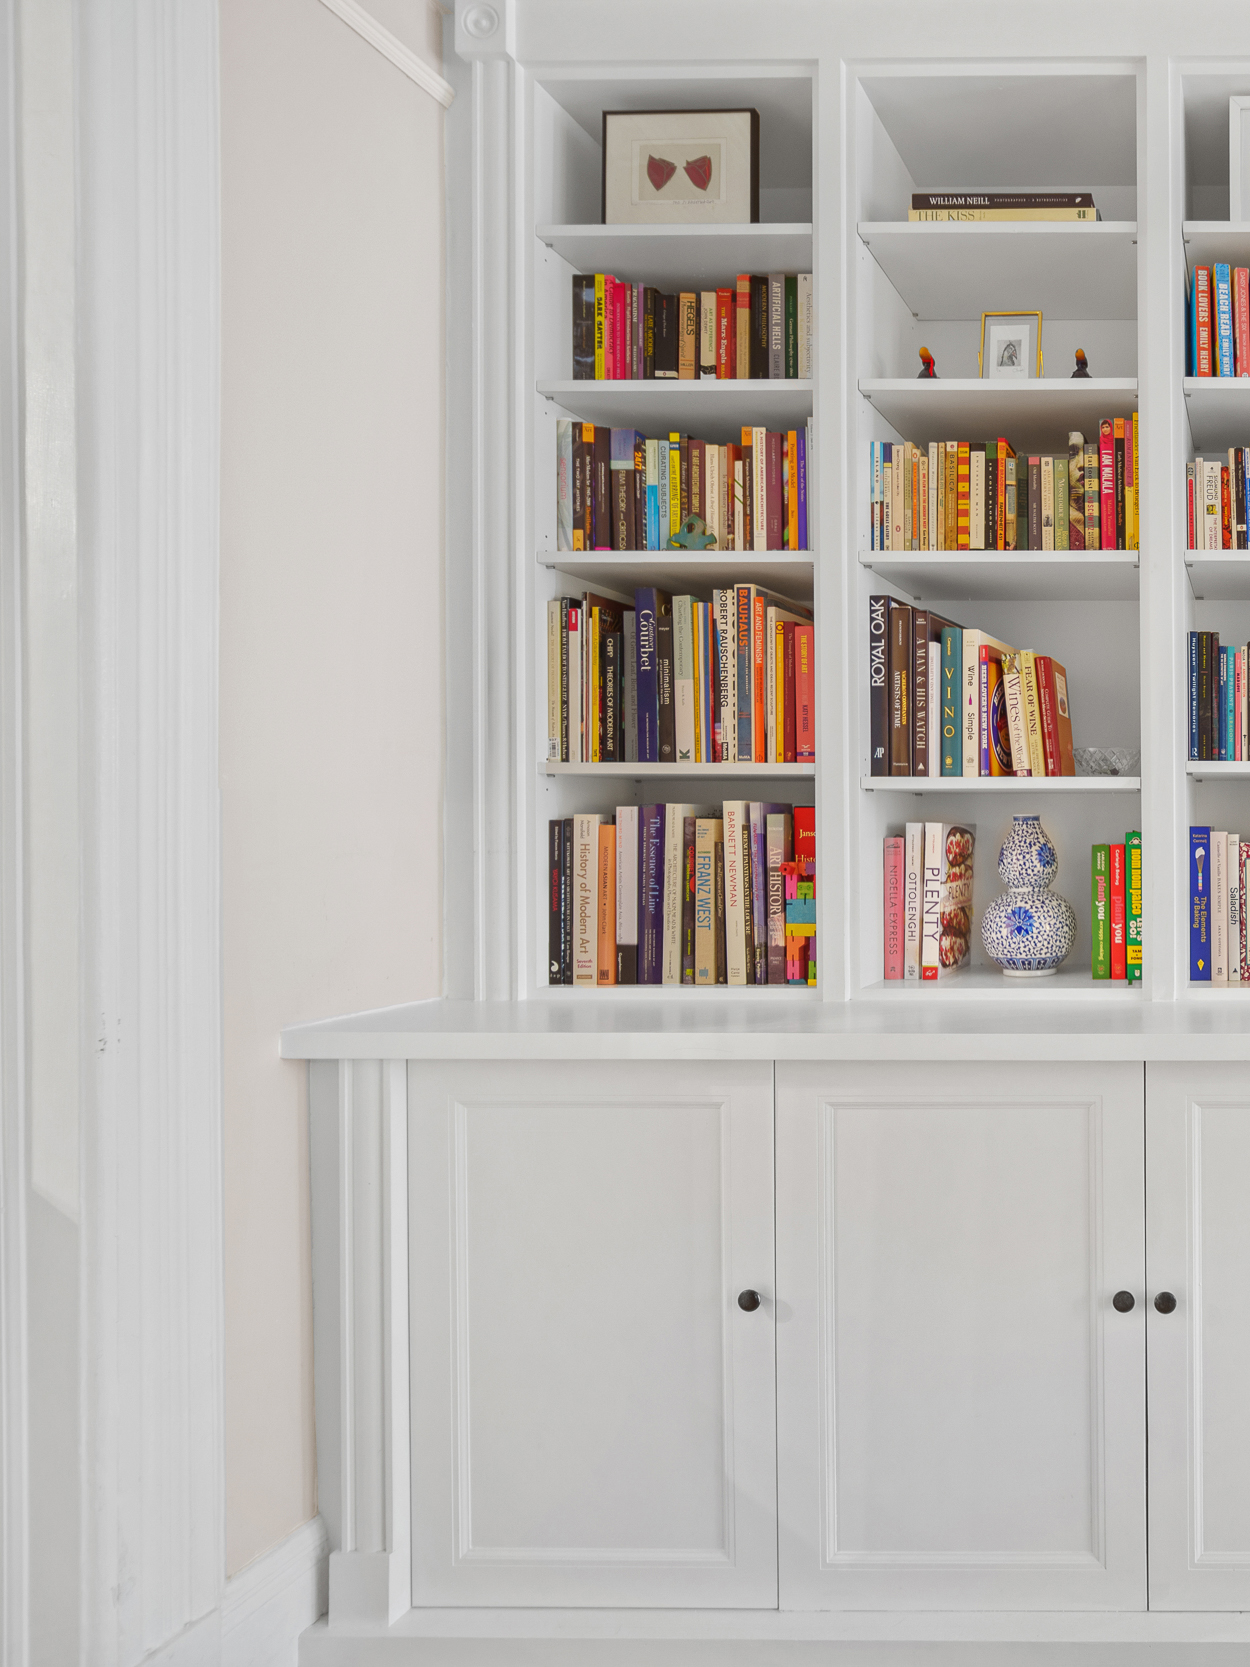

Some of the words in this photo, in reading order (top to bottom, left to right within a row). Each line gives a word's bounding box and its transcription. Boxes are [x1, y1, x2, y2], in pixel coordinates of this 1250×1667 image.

[929, 197, 964, 205] WILLIAM
[967, 197, 990, 205] NEILL
[915, 211, 943, 221] THE
[947, 211, 975, 221] KISS
[1198, 270, 1207, 291] BOOK
[772, 281, 781, 324] ARTIFICIAL
[1199, 293, 1208, 322] LOVERS
[1219, 283, 1228, 311] BEACH
[772, 326, 781, 350] HELLS
[1200, 327, 1208, 348] EMILY
[1220, 313, 1230, 336] READ
[1200, 350, 1208, 373] HENRY
[1102, 455, 1113, 465] AM
[560, 458, 569, 500] sensorium
[1102, 467, 1113, 494] MALALA
[720, 589, 728, 627] ROBERT
[739, 589, 748, 646] BAUHAUS
[871, 600, 884, 634] OAK
[640, 610, 654, 671] Courbet
[720, 629, 728, 708] RAUSCHENBERG
[871, 640, 884, 687] ROYAL
[917, 648, 925, 672] MAN
[967, 665, 975, 687] Wine
[917, 688, 925, 707] HIS
[943, 668, 955, 738] VINO
[1007, 676, 1022, 722] Wines
[966, 712, 975, 741] Simple
[1012, 724, 1021, 733] of
[1027, 694, 1033, 709] OF
[1030, 709, 1038, 736] WINE
[917, 711, 925, 749] WATCH
[1013, 733, 1023, 746] the
[1015, 746, 1025, 769] World
[650, 816, 661, 836] The
[728, 811, 736, 856] BARNETT
[577, 843, 590, 879] History
[649, 838, 660, 875] Essence
[769, 846, 782, 869] ART
[1131, 848, 1141, 867] nom
[580, 882, 591, 893] of
[649, 878, 660, 888] of
[698, 856, 711, 894] FRANZ
[1131, 869, 1141, 888] nom
[648, 891, 659, 914] Line
[769, 871, 782, 918] HISTORY
[925, 868, 940, 942] PLENTY
[949, 883, 971, 900] PLENTY
[1095, 876, 1106, 920] plantyou
[1129, 889, 1141, 915] paleo
[1230, 887, 1238, 925] Saladish
[580, 895, 590, 934] Modern
[698, 898, 711, 930] WEST
[908, 872, 916, 942] OTTOLENGHI
[1113, 896, 1123, 944] plantyou
[580, 937, 590, 954] Art
[889, 912, 897, 955] EXPRESS
